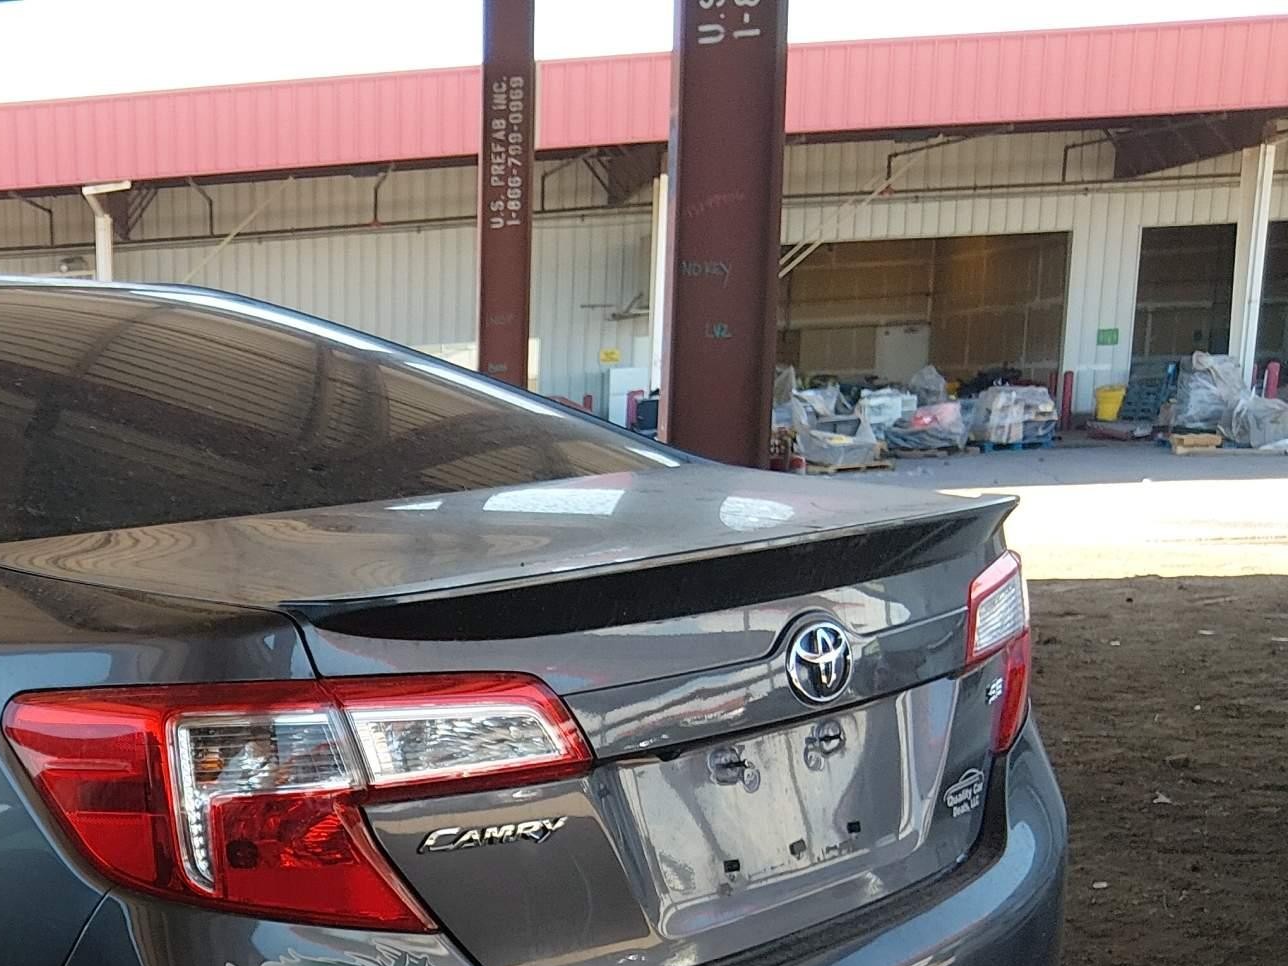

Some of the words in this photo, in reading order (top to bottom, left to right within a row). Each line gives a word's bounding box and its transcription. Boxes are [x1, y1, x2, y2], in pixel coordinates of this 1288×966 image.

[492, 75, 507, 111] INC.
[490, 118, 506, 187] PREFAB
[490, 193, 505, 229] U.S.
[416, 816, 568, 855] CAMRY
